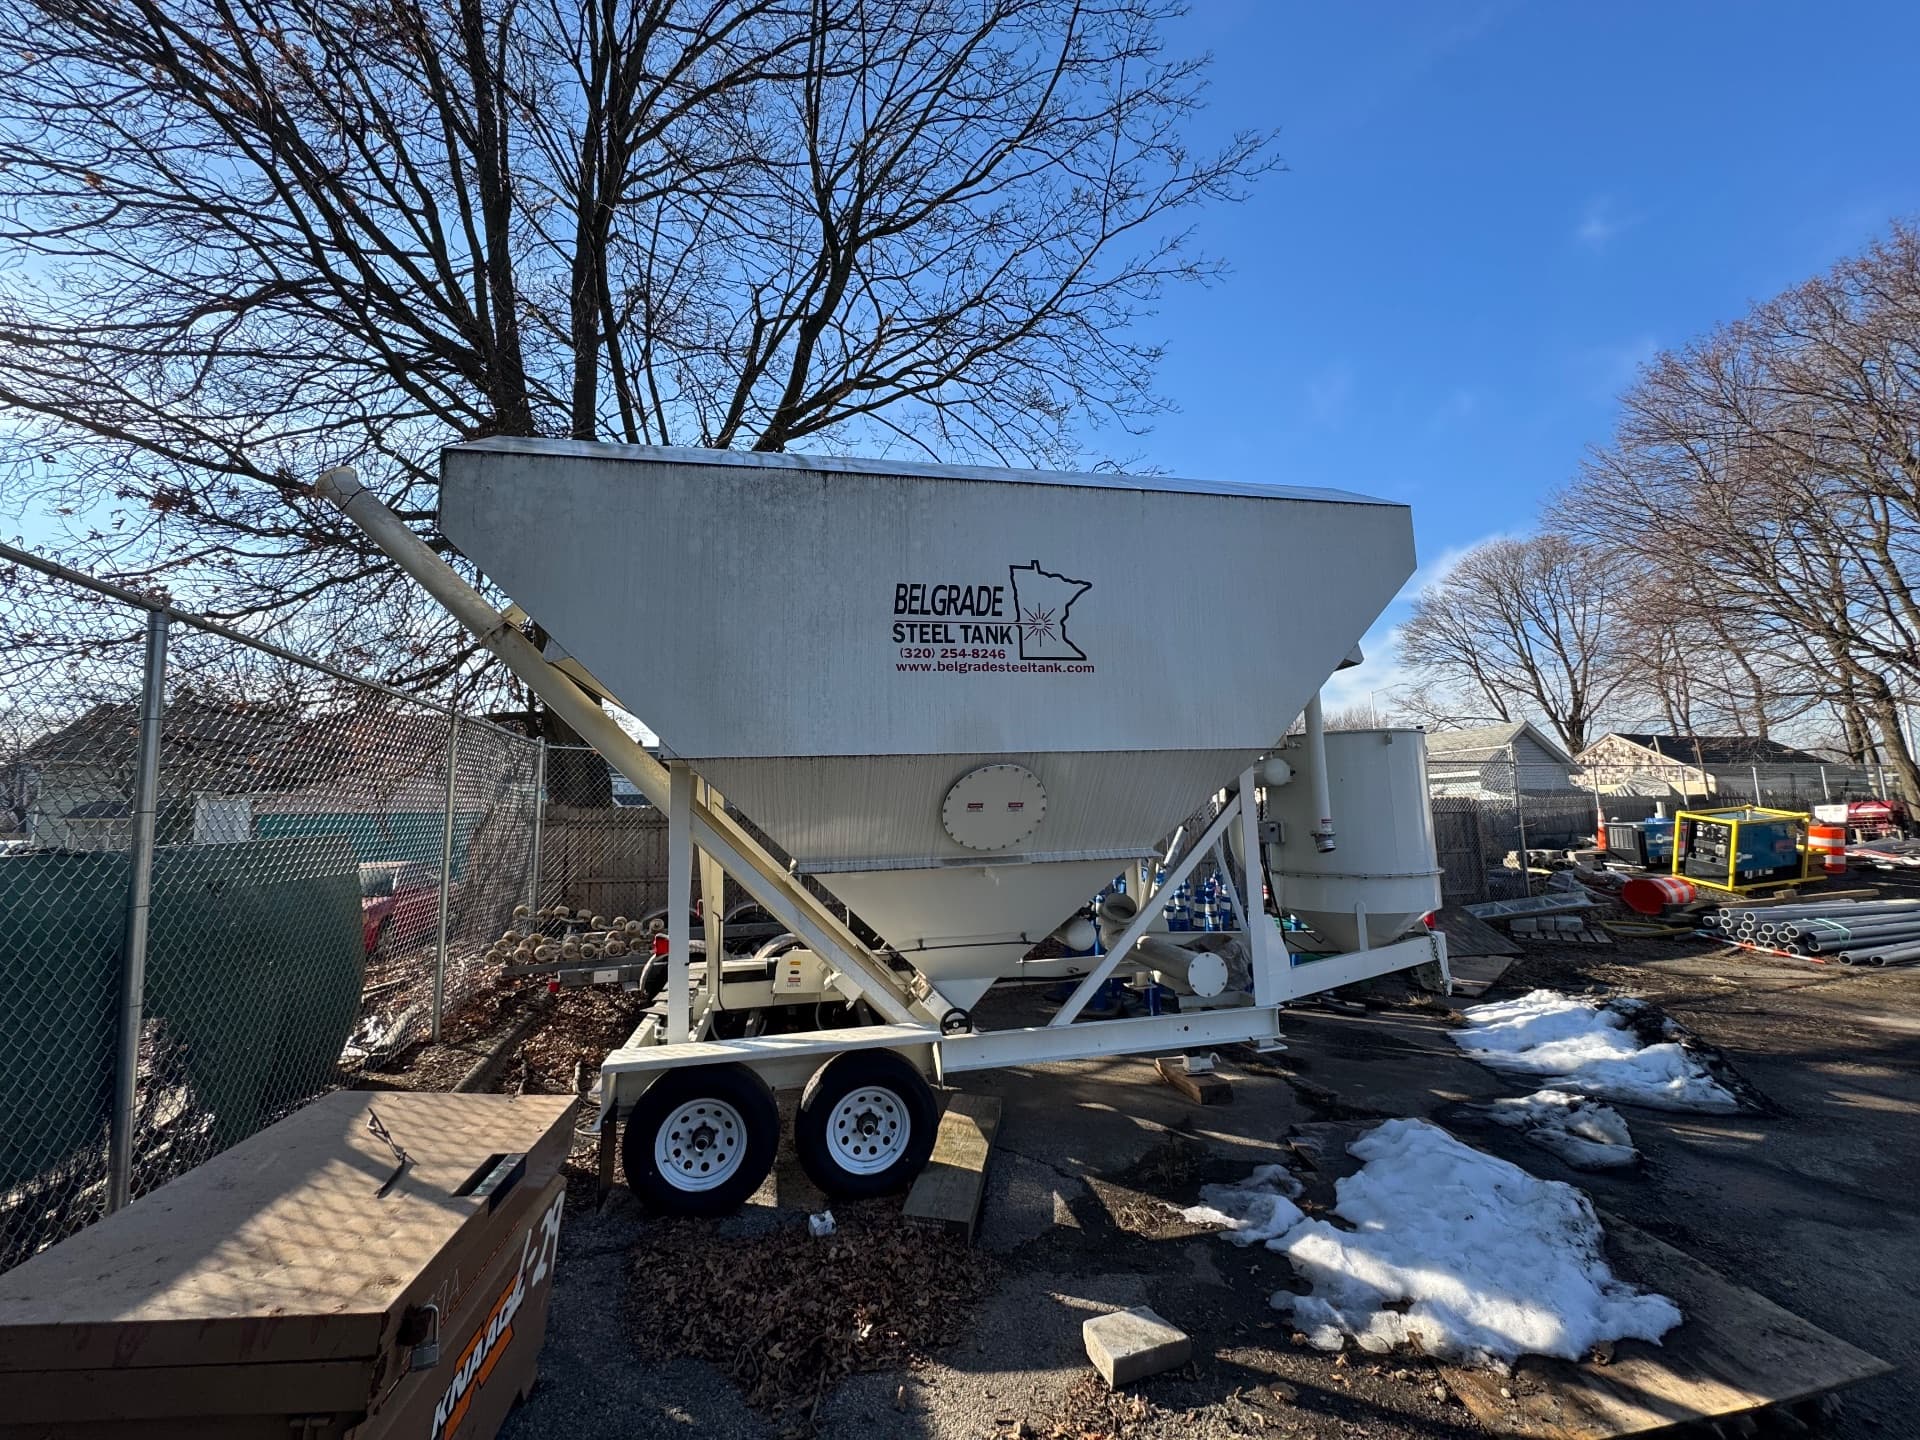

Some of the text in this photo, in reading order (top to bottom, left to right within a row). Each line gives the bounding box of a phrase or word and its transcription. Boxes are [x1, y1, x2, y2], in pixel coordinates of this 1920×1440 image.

[894, 583, 1004, 617] BELGRADE
[892, 623, 1014, 645] STEEL TANK
[900, 647, 1006, 660] (320) 254-8246
[896, 660, 1095, 674] www.belgradesteeltank.com
